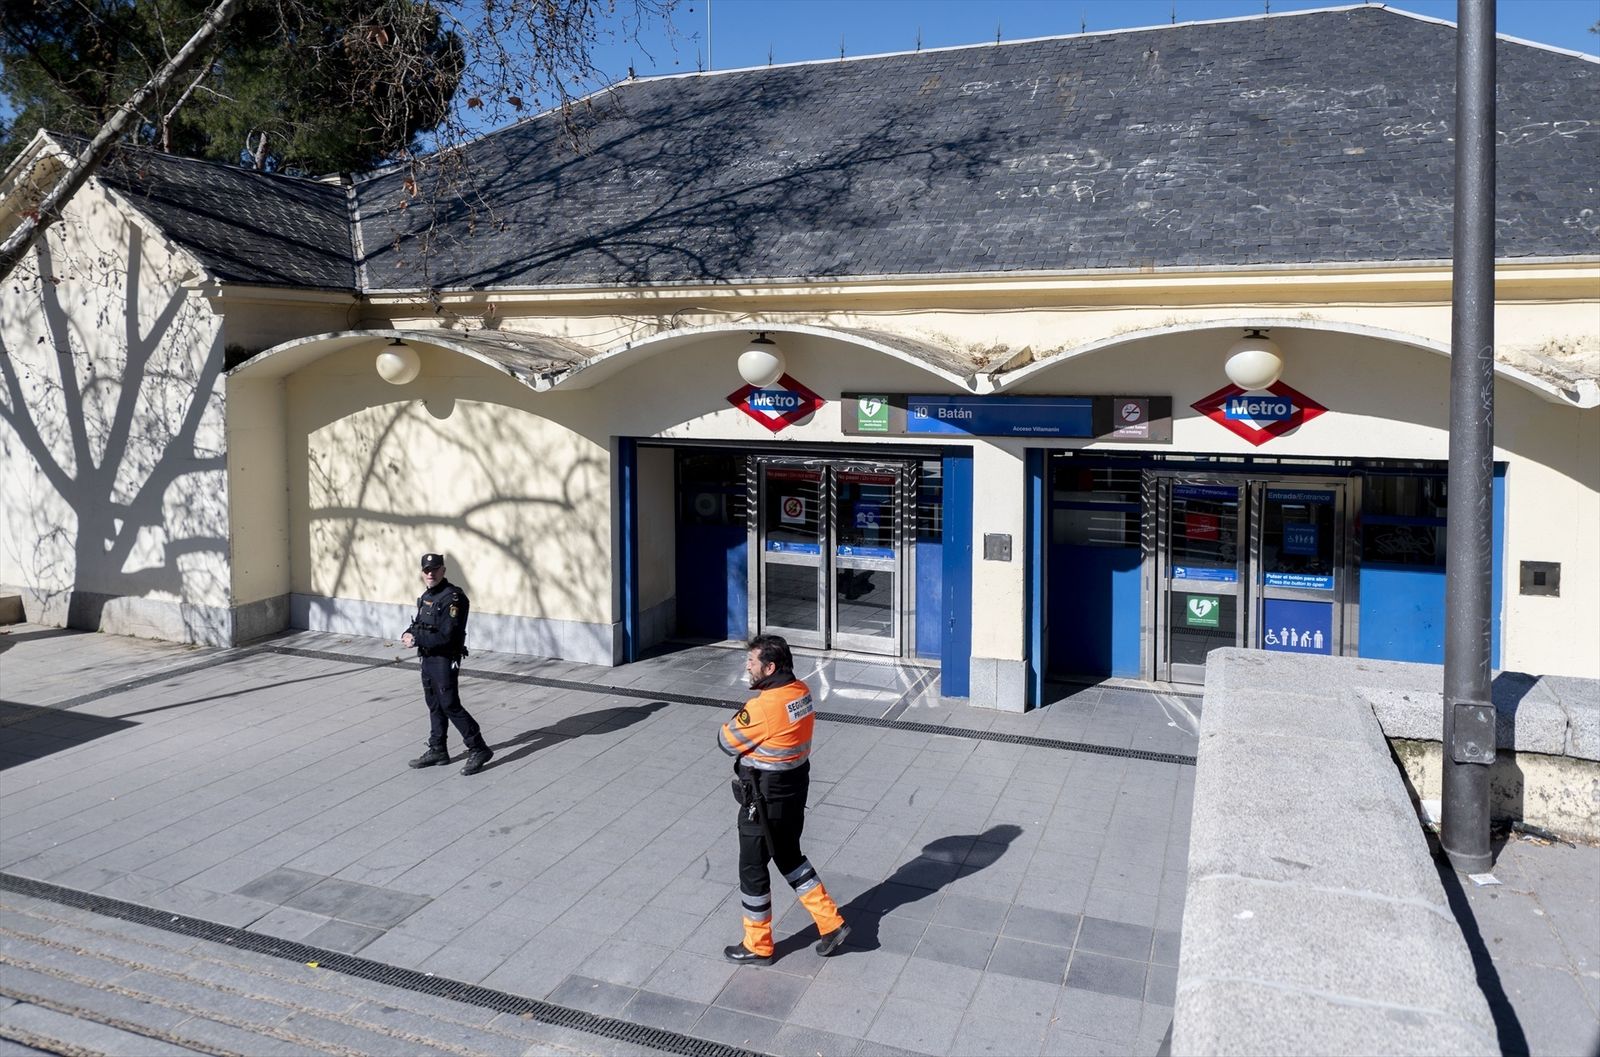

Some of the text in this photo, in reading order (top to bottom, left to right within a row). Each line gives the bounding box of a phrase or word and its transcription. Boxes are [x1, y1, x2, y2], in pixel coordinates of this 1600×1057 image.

[754, 393, 795, 407] Metro
[1231, 399, 1287, 415] Metro
[914, 407, 973, 419] 10 Batán
